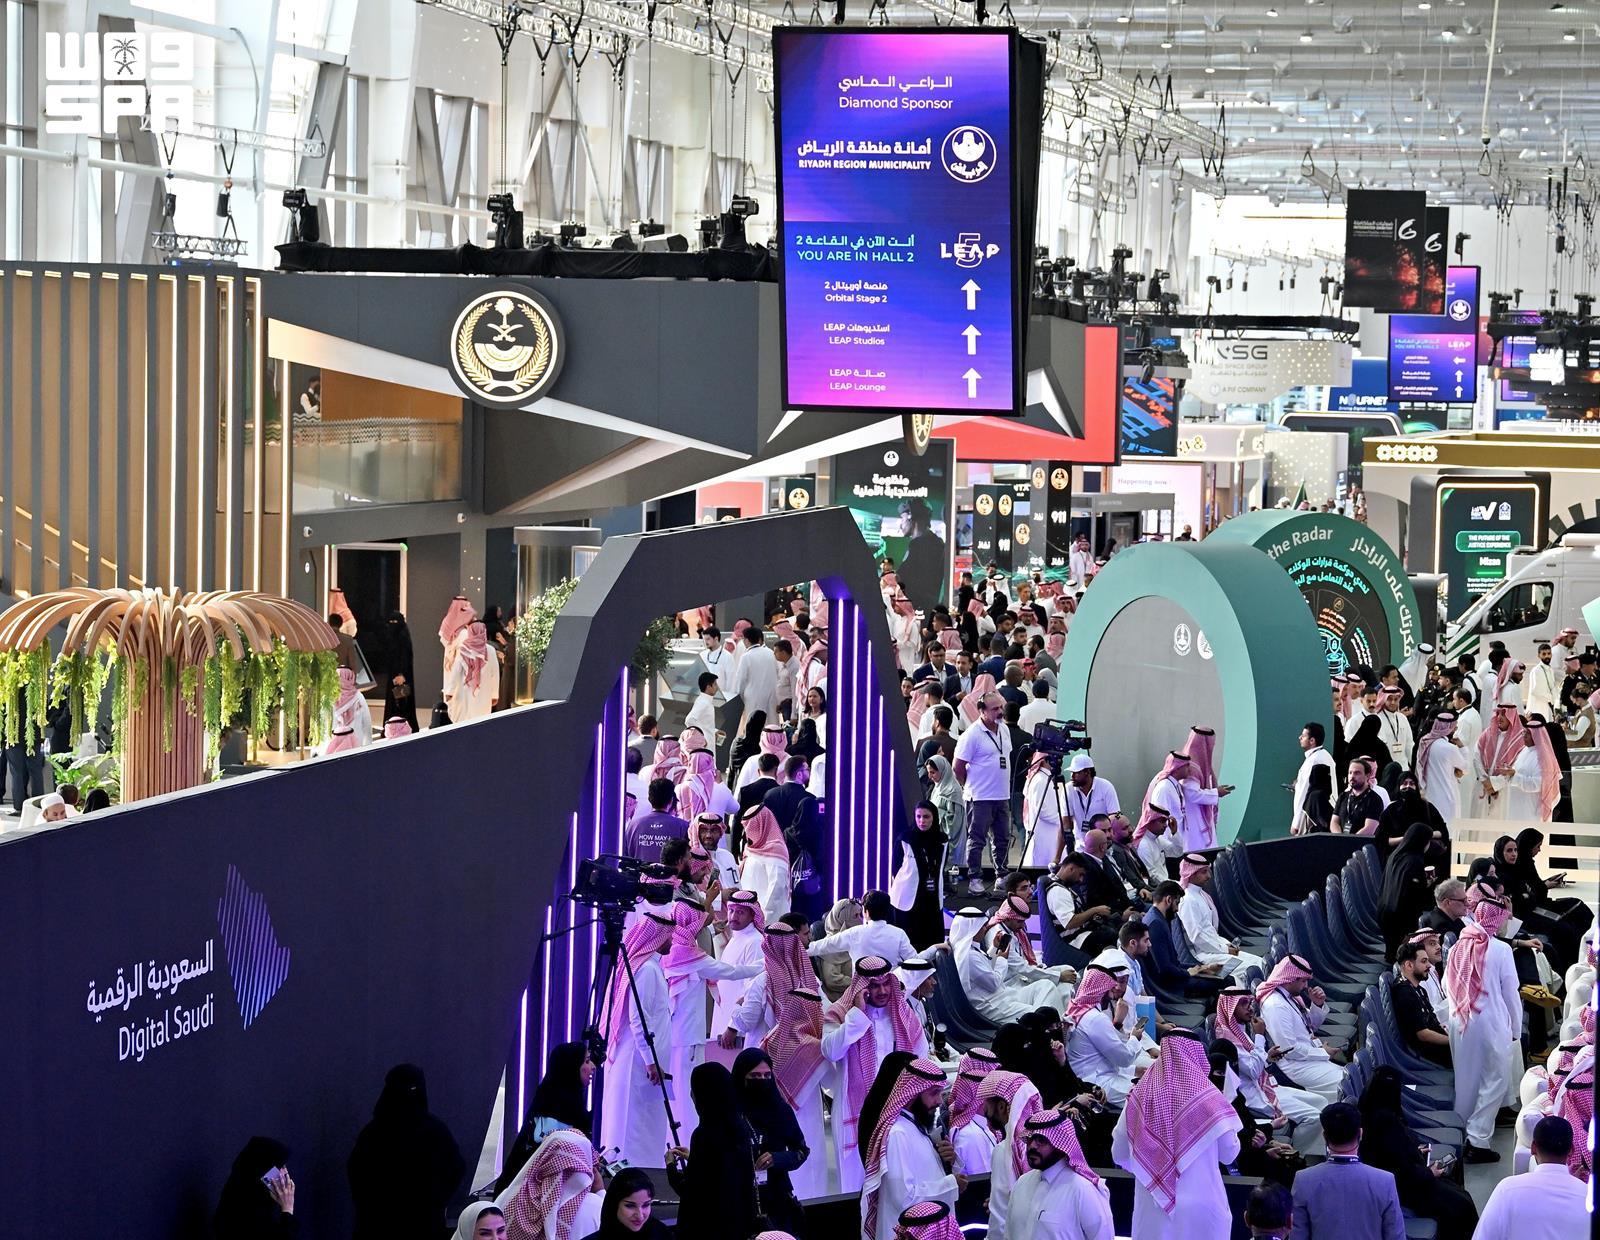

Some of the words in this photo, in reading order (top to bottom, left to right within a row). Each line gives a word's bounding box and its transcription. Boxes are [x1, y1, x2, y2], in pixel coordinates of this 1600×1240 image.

[838, 76, 896, 92] الماسي
[898, 76, 953, 92] الراعي
[839, 96, 898, 109] Diamond
[901, 97, 953, 111] Sponsor
[797, 139, 844, 157] الرياض
[847, 140, 892, 155] منطقة
[893, 138, 932, 155] أمانة
[798, 160, 832, 169] RIYADH
[833, 160, 867, 170] REGION
[868, 160, 932, 170] MUNICIPALITY
[796, 236, 804, 246] 2
[805, 235, 848, 247] القاعة
[850, 236, 864, 250] في
[866, 235, 885, 247] الآن
[887, 234, 915, 247] أنت
[797, 251, 824, 262] YOU
[826, 251, 851, 262] ARE
[855, 252, 868, 262] IN
[872, 252, 904, 262] HALL
[907, 252, 915, 263] 2
[940, 243, 1000, 259] LEAP
[824, 281, 830, 290] 2
[863, 281, 888, 291] منصة
[825, 294, 854, 303] Orbital
[856, 294, 881, 304] Stage
[882, 295, 888, 303] 2
[823, 323, 846, 332] LEAP
[829, 336, 852, 345] LEAP
[853, 336, 885, 346] Studios
[829, 368, 852, 377] LEAP
[829, 382, 852, 391] LEAP
[854, 382, 886, 392] Lounge
[1267, 539, 1291, 560] the
[1291, 525, 1334, 547] Radar
[1349, 537, 1388, 571] الرادار
[1384, 568, 1404, 604] على
[147, 938, 214, 1000] السعودية
[86, 962, 143, 1024] الرقمية
[118, 1009, 170, 1063] Digital
[173, 993, 214, 1040] Saudi
